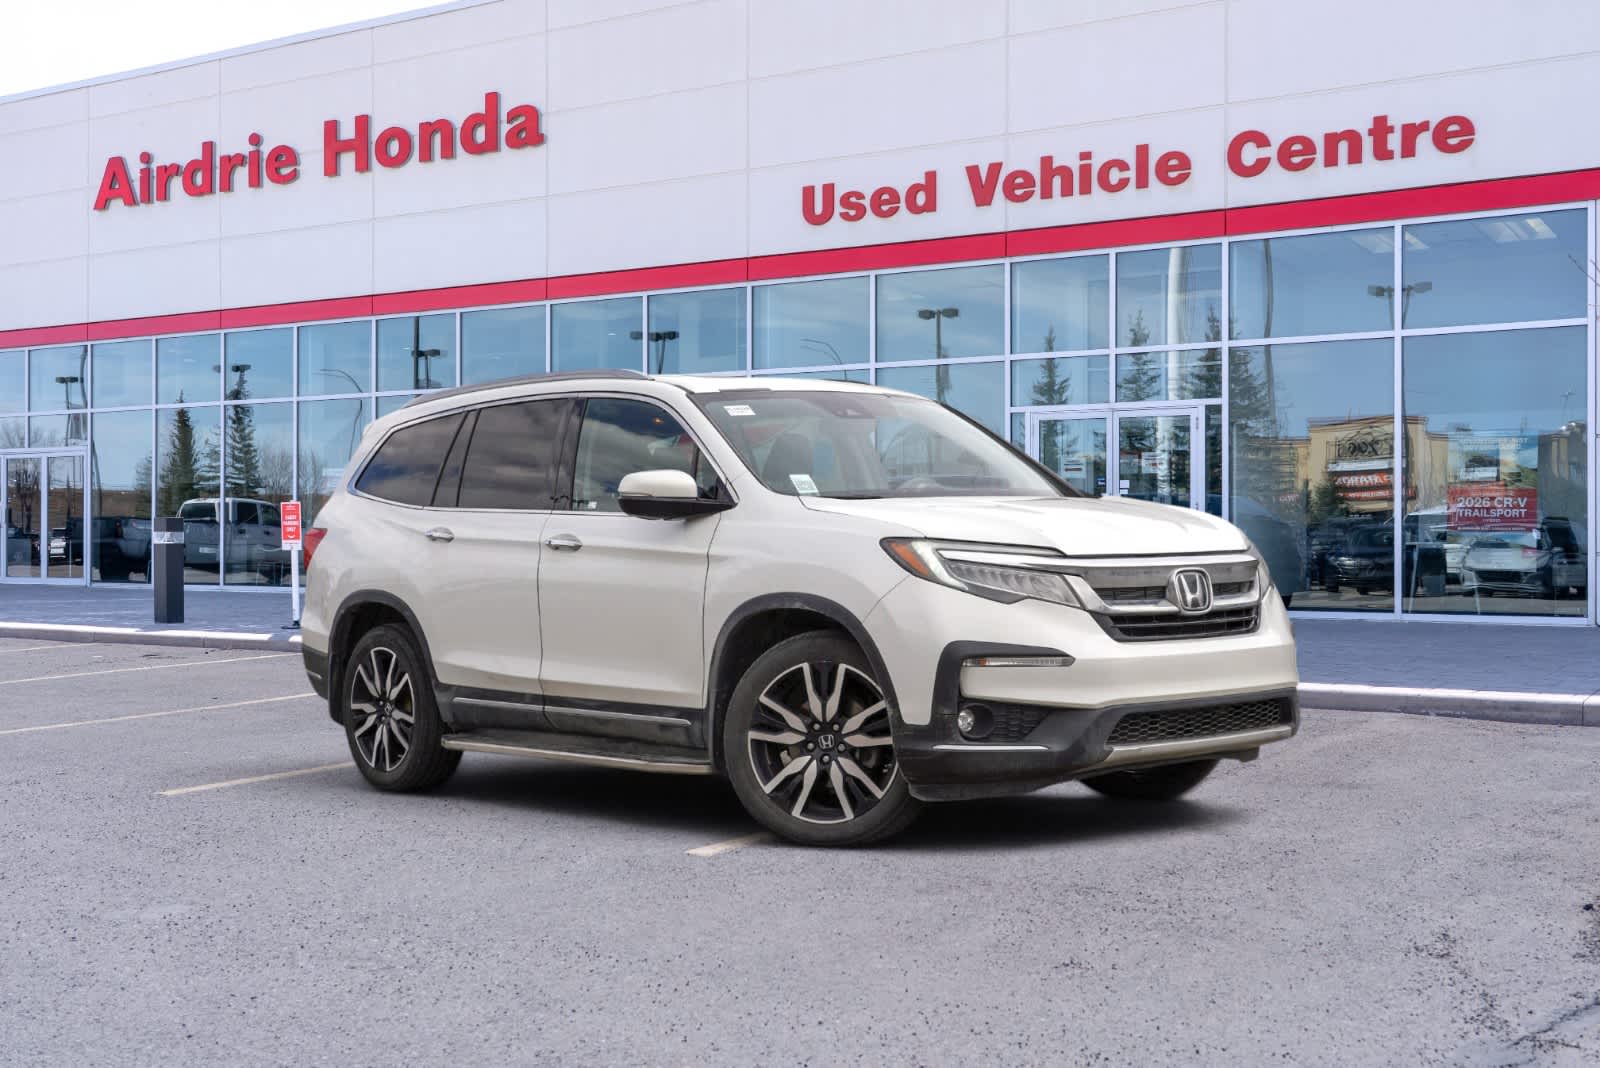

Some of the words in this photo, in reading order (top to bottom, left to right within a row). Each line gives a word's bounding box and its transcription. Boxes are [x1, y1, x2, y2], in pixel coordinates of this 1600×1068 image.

[94, 133, 299, 211] Airdrie
[323, 91, 546, 177] Honda
[801, 170, 937, 226] Used
[965, 143, 1192, 207] Vehicle
[1226, 115, 1476, 178] Centre
[1457, 497, 1490, 507] 2026
[1494, 497, 1527, 507] CR-V
[1458, 509, 1527, 518] TRAILSPORT
